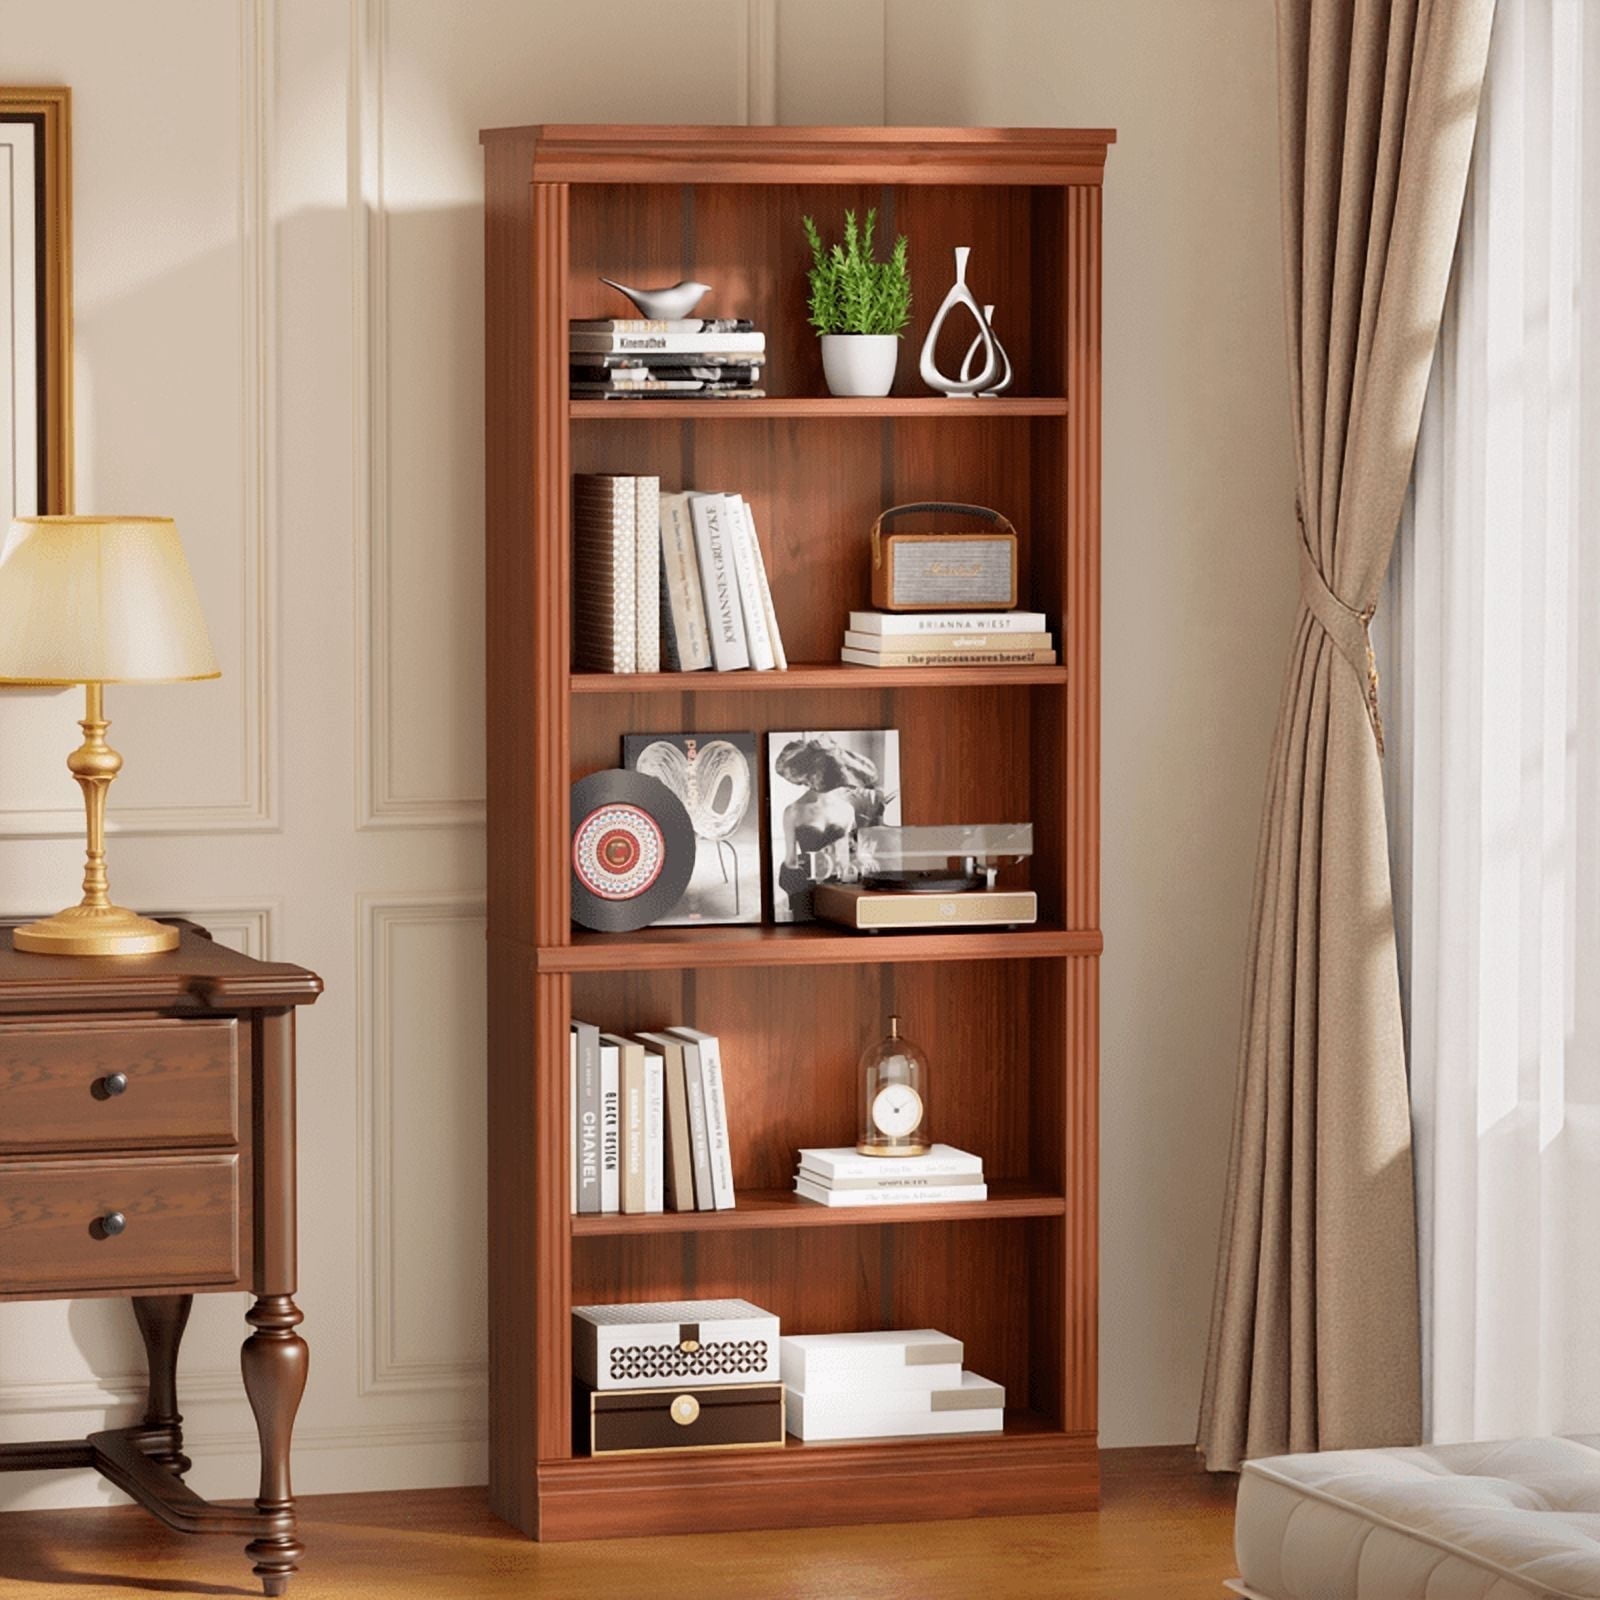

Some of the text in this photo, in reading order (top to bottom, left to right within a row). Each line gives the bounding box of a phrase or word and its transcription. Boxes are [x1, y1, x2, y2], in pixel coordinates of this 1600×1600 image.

[619, 337, 667, 349] Kinemathek
[717, 573, 736, 644] JOHANNES
[919, 620, 1011, 630] BRIANNA WIEST
[907, 655, 924, 663] the
[999, 652, 1035, 662] herself
[582, 1111, 596, 1188] CHANEL
[604, 1091, 617, 1171] BLACK DESIGN
